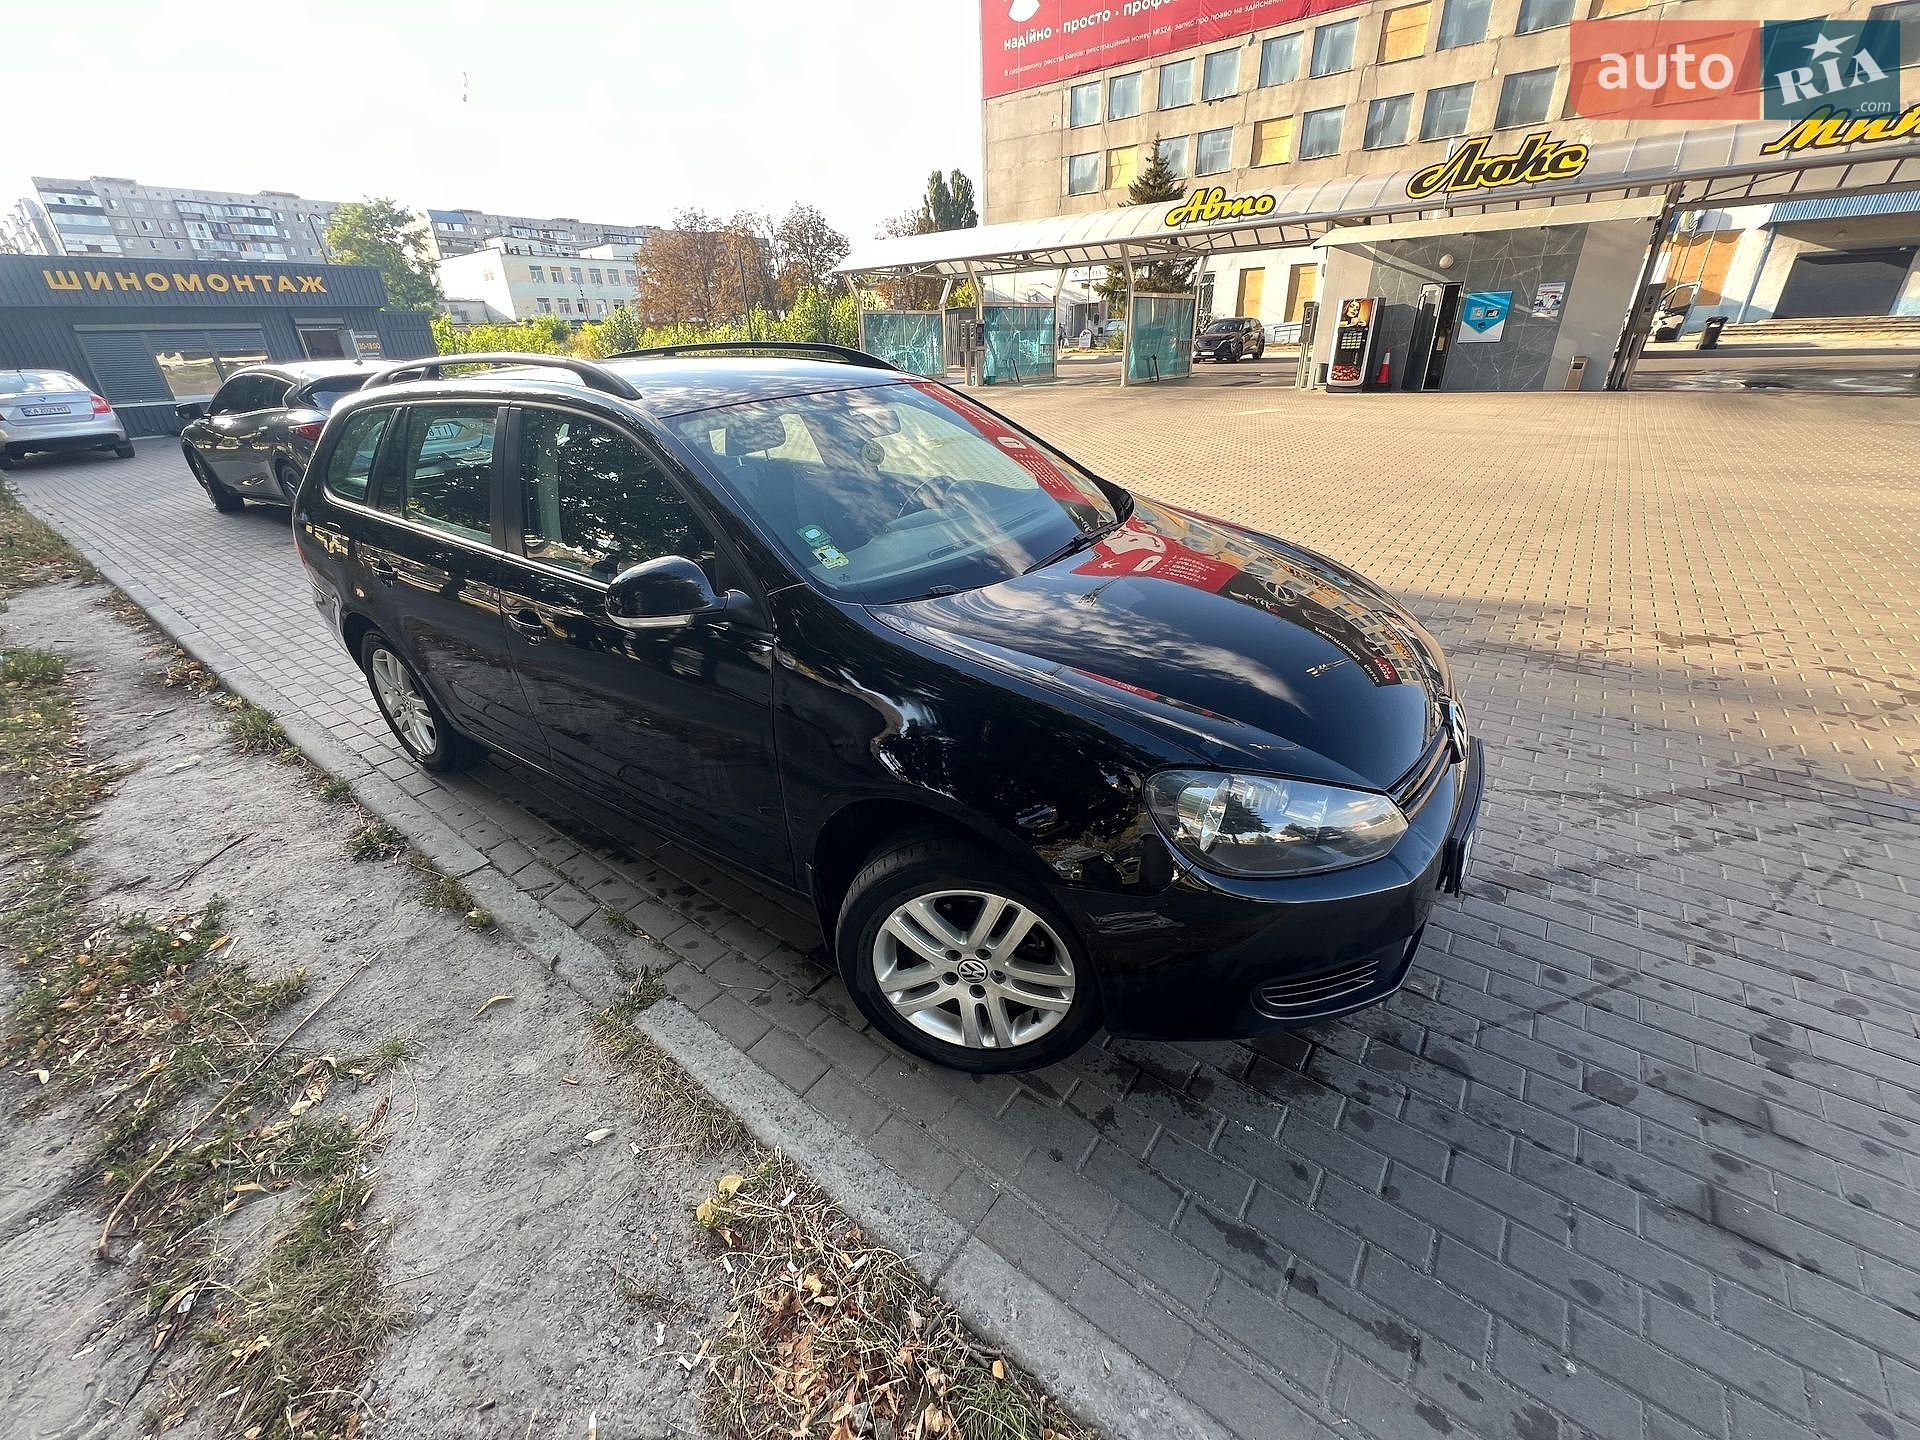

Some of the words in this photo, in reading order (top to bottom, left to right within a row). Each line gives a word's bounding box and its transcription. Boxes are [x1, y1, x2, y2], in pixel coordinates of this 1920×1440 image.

[1003, 26, 1052, 51] надійно
[1063, 9, 1111, 33] просто
[1123, 0, 1171, 16] проф
[1210, 10, 1232, 22] право
[1164, 186, 1278, 228] Авто
[1406, 130, 1590, 200] Люкс
[42, 269, 328, 294] ШИНОМОНТАЖ
